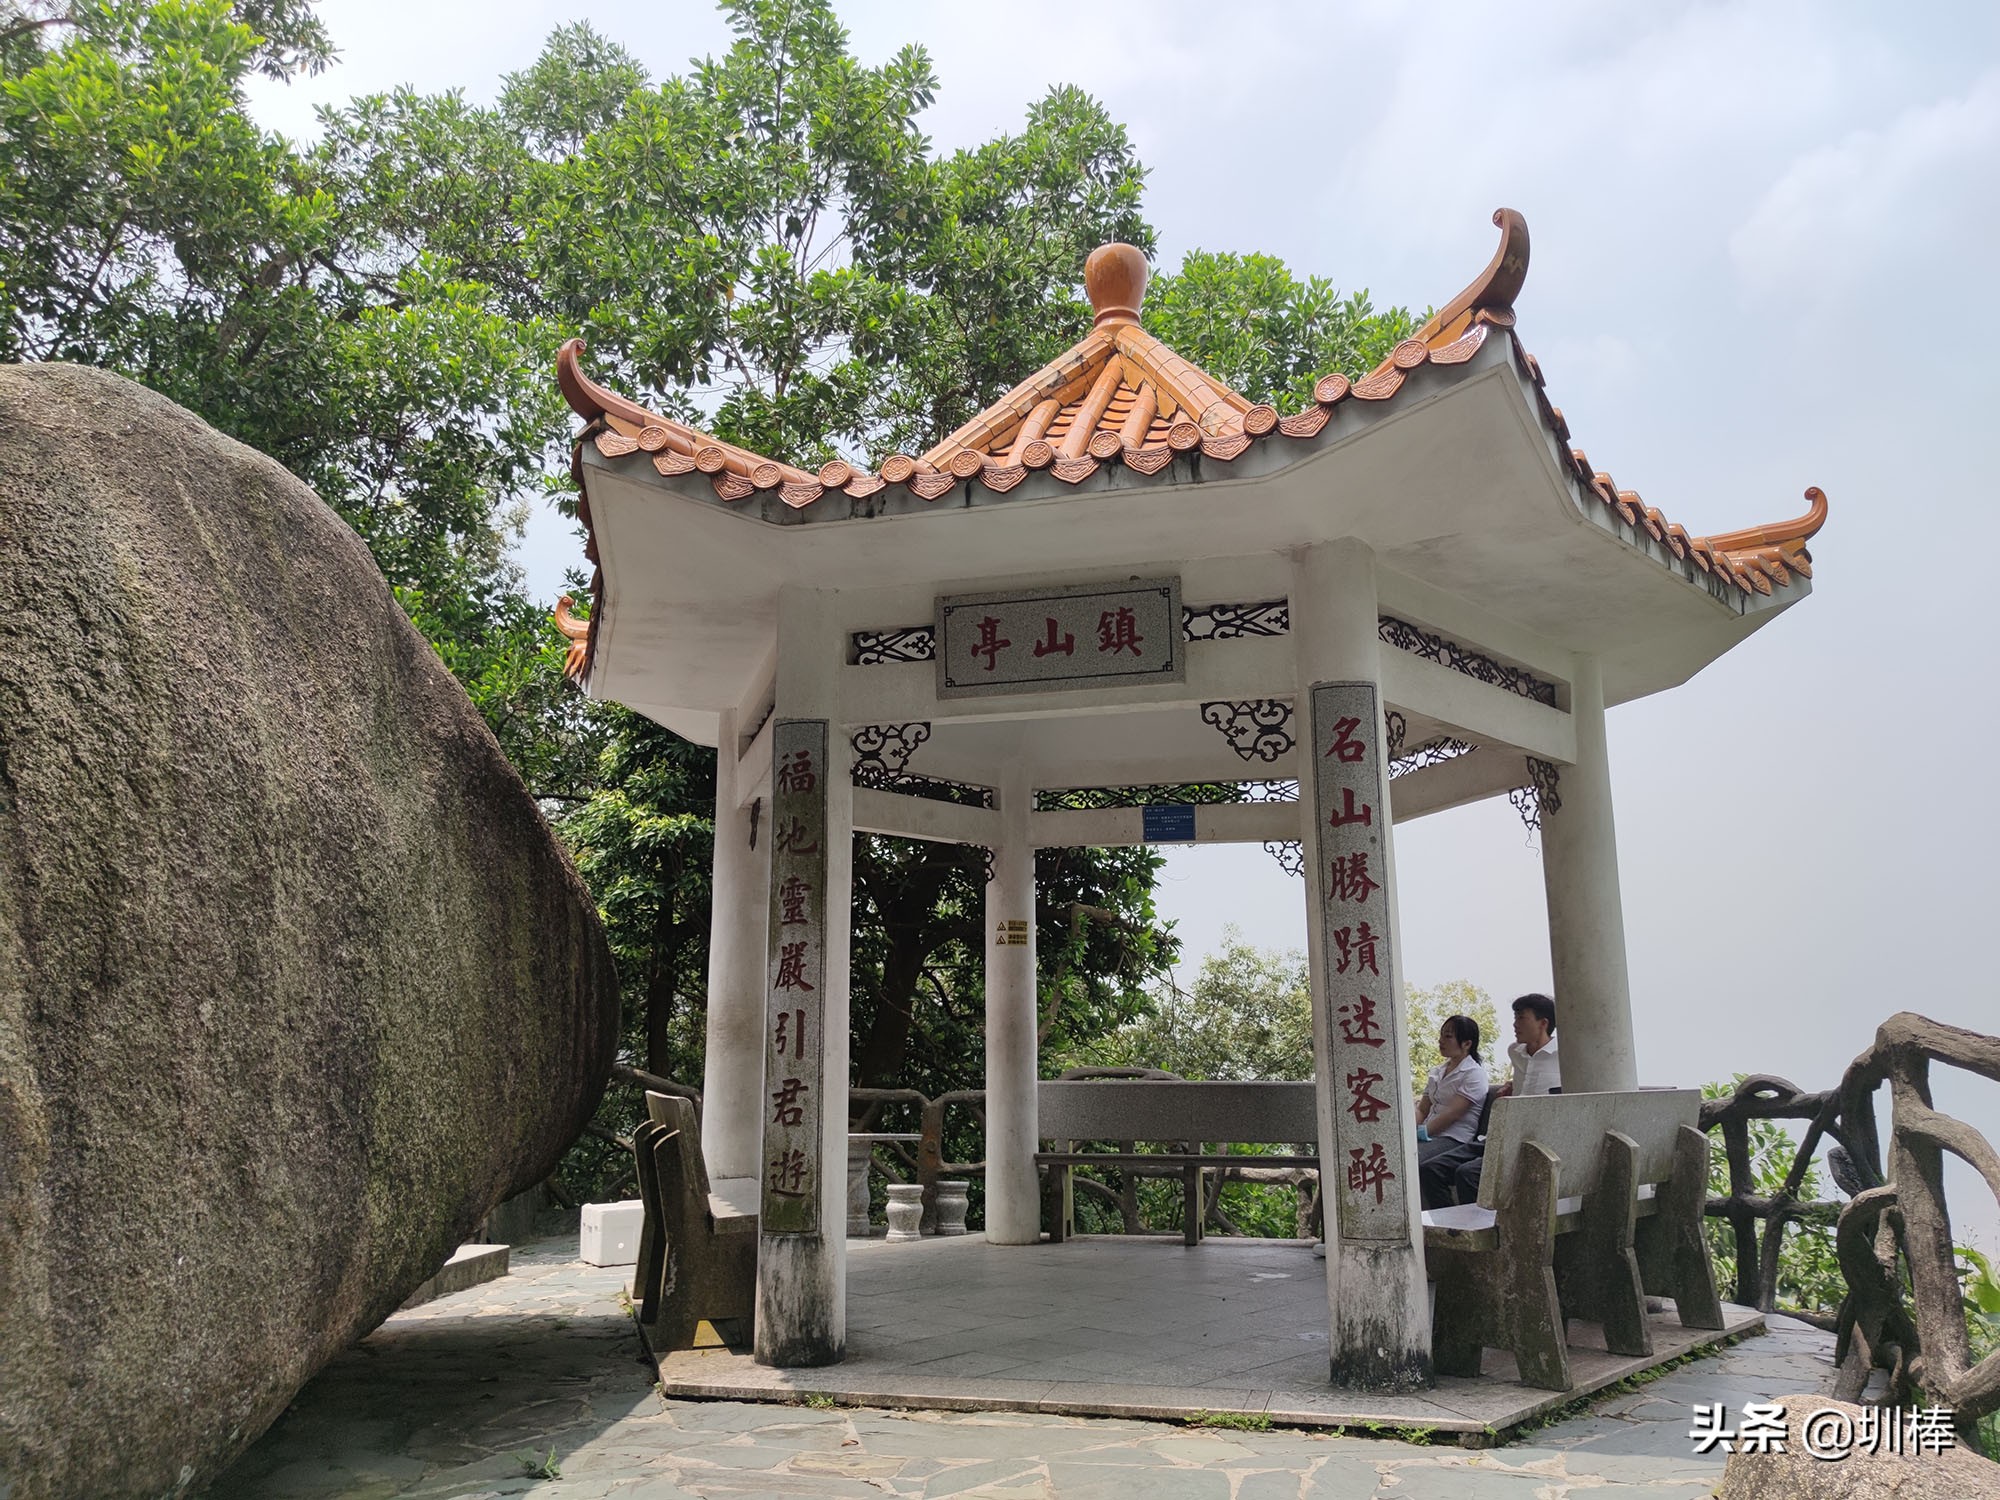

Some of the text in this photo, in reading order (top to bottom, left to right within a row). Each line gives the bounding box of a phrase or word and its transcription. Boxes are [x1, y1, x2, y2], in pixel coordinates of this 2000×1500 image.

[1324, 716, 1395, 1204] 名山勝蹟迷客醉
